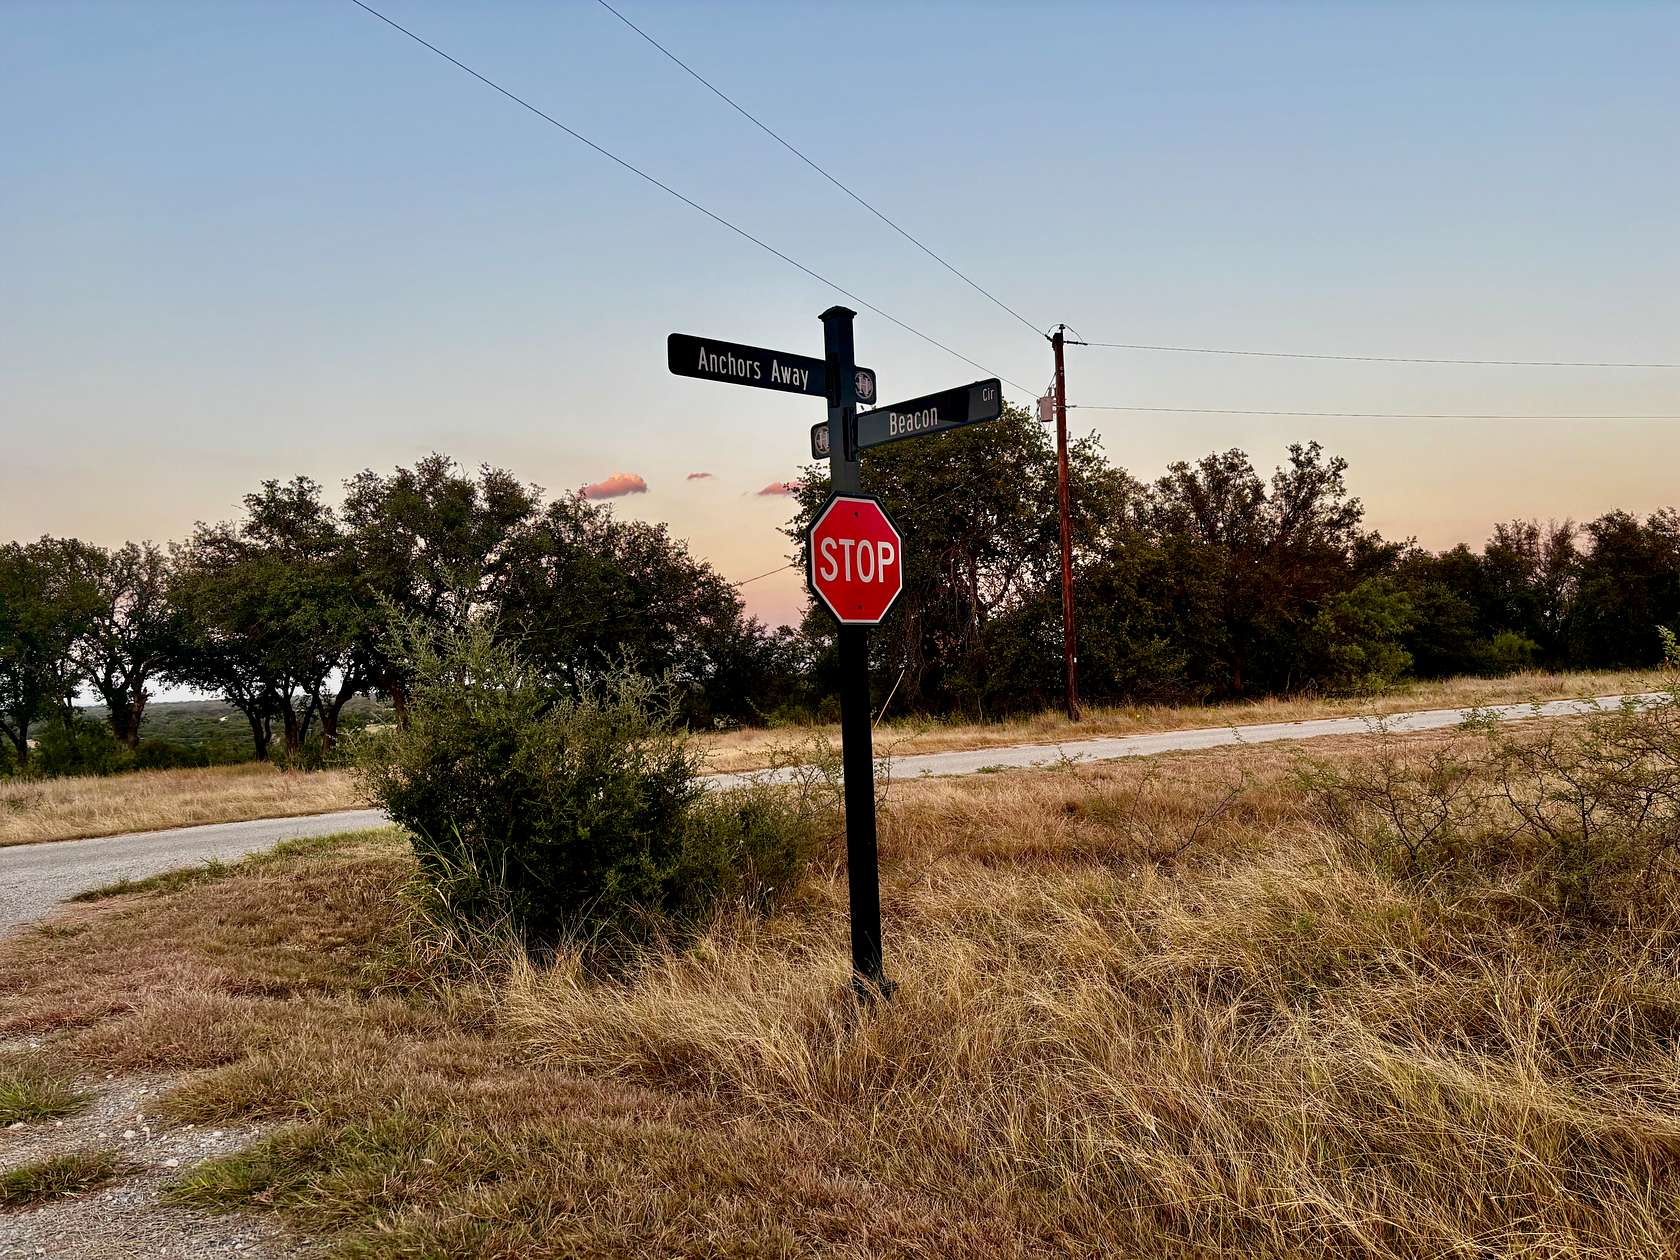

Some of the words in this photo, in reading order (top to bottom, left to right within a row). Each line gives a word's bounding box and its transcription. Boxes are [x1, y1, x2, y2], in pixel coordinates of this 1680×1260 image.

[698, 346, 761, 380] Anchors
[771, 359, 809, 391] Away
[889, 407, 938, 436] Beacon
[982, 387, 995, 402] Cir
[820, 536, 895, 583] STOP
